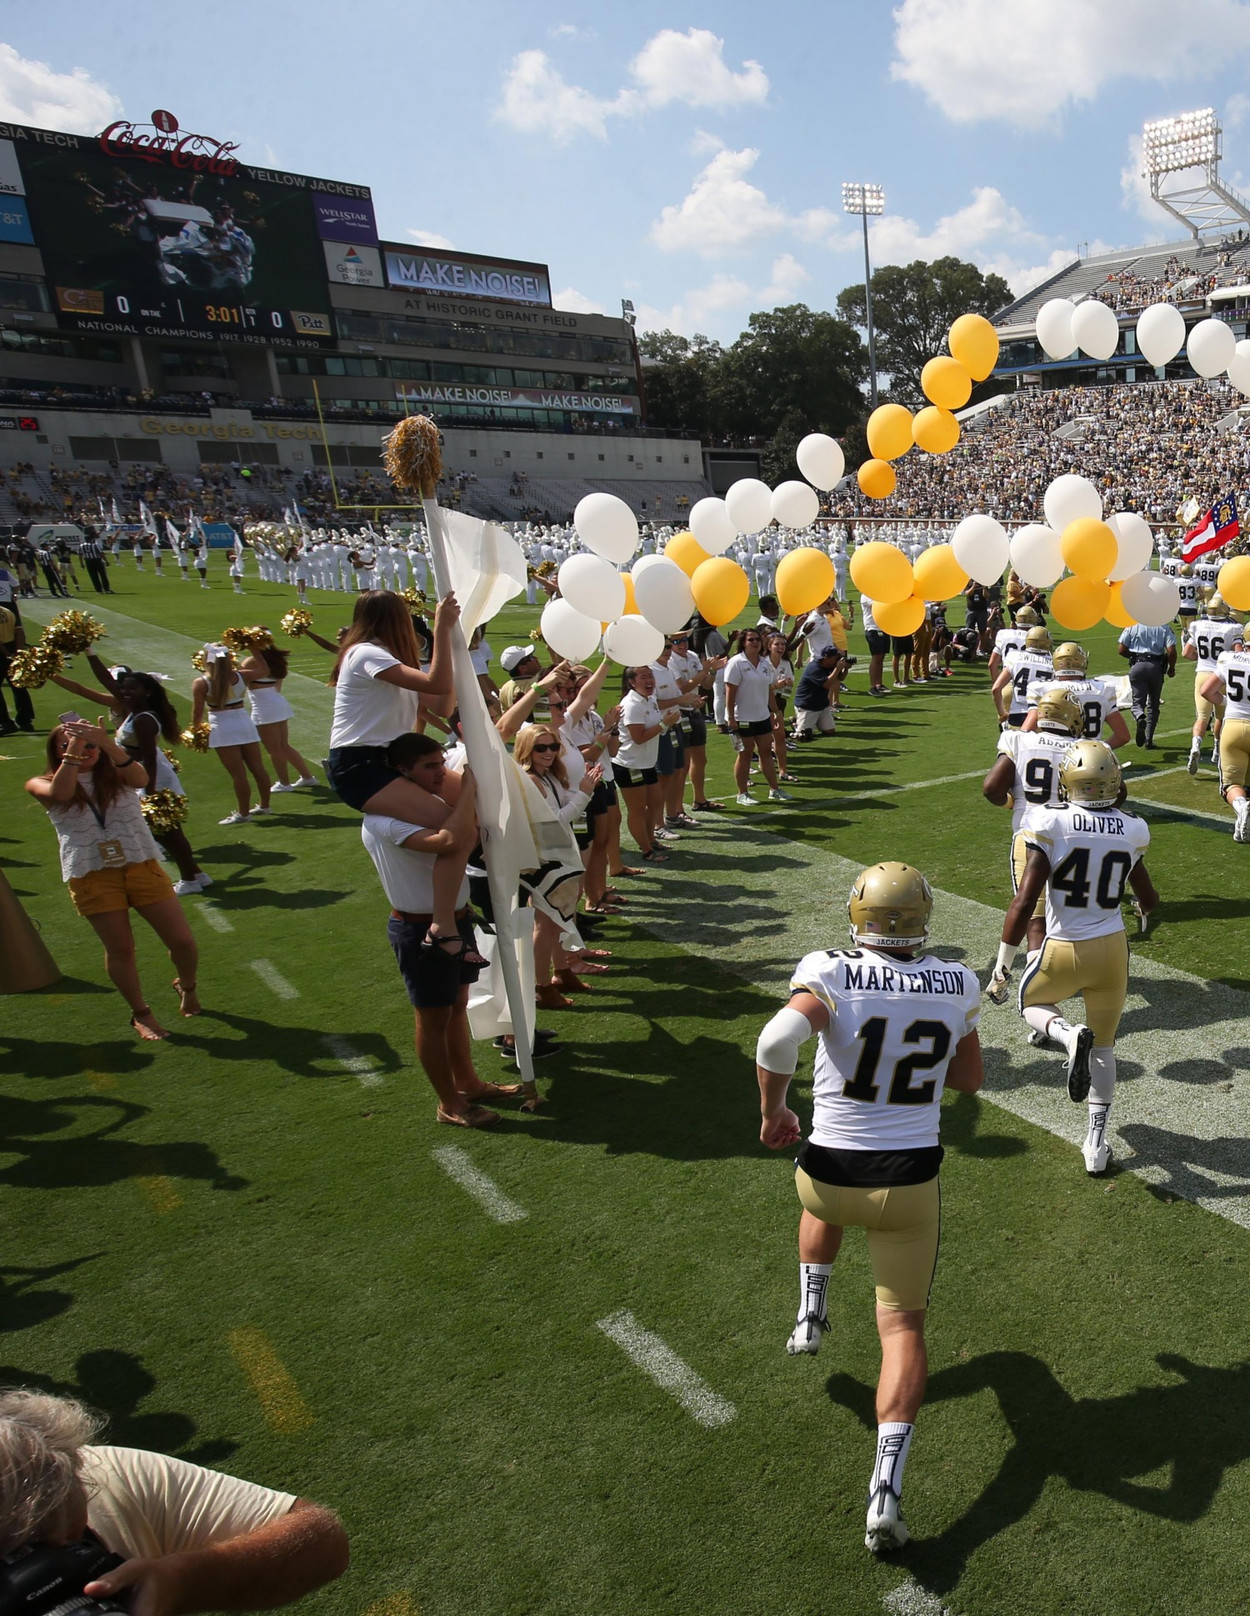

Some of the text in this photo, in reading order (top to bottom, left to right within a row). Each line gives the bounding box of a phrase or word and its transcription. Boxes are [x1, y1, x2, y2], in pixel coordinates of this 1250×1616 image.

[31, 130, 79, 148] TECH
[100, 120, 241, 177] Coca-Cola
[248, 168, 370, 199] YELLOW JACKETS
[336, 264, 373, 277] Georgia
[342, 274, 371, 284] Power
[398, 257, 540, 299] MAKE NOISE!
[116, 295, 129, 314] 0
[405, 300, 577, 328] AT HISTORIC GRANT FIELD
[205, 305, 239, 324] 3:01
[271, 311, 283, 328] 0
[298, 314, 324, 329] Pitt
[249, 316, 256, 326] 1
[78, 320, 138, 333] NATIONAL
[145, 326, 213, 340] CHAMPIONS
[421, 387, 622, 410] MAKE NOISE! MAKE NOISE!
[140, 417, 323, 440] Georgia Tech
[1201, 569, 1215, 582] 89
[1197, 635, 1225, 660] 66
[1088, 800, 1111, 808] JACKETS
[1073, 813, 1125, 836] OLIVER
[1051, 847, 1132, 910] 40
[876, 938, 910, 947] JACKETS
[844, 963, 965, 996] MARTENSON
[841, 1015, 953, 1106] 12
[26, 1576, 63, 1601] Canon
